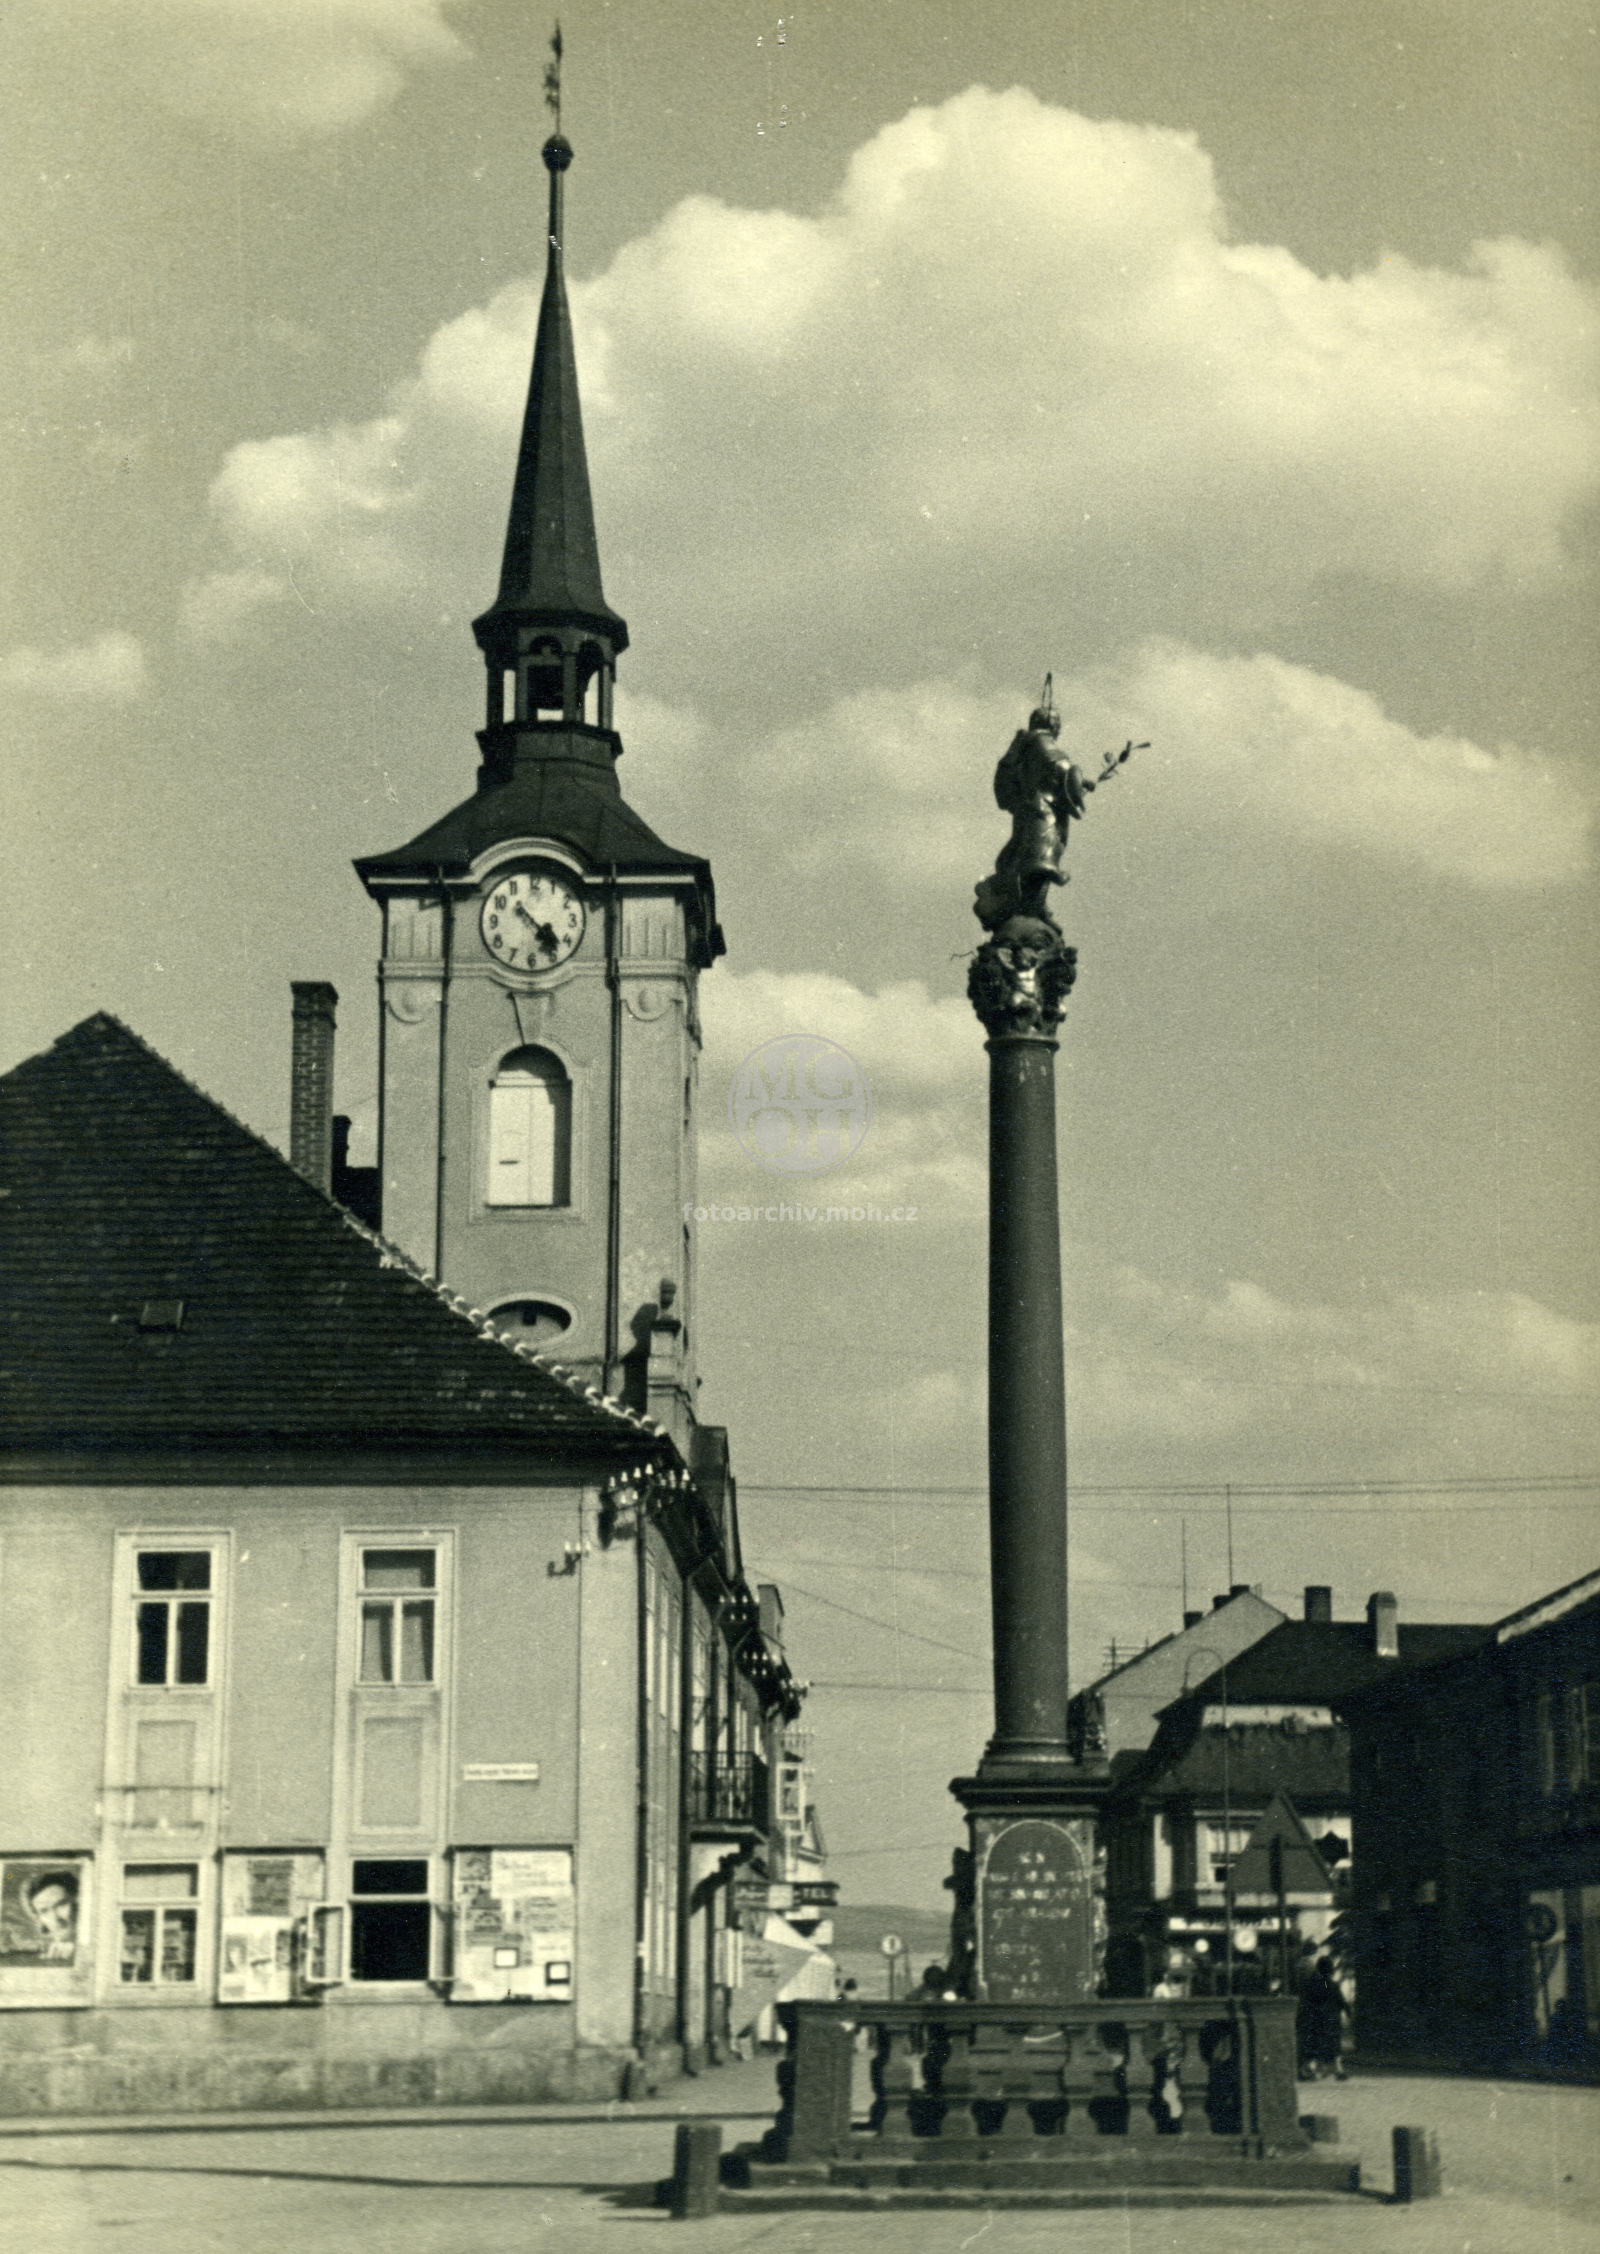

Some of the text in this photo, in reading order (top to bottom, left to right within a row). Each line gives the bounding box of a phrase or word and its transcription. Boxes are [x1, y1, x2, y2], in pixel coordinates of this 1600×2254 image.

[509, 881, 518, 896] 11
[530, 875, 541, 891] 12
[495, 895, 507, 910] 10
[563, 894, 571, 909] 2
[489, 914, 498, 929] 9
[568, 913, 577, 928] 3
[493, 934, 503, 949] 8
[563, 933, 572, 948] 4
[509, 948, 518, 962] 7
[527, 953, 537, 969] 6
